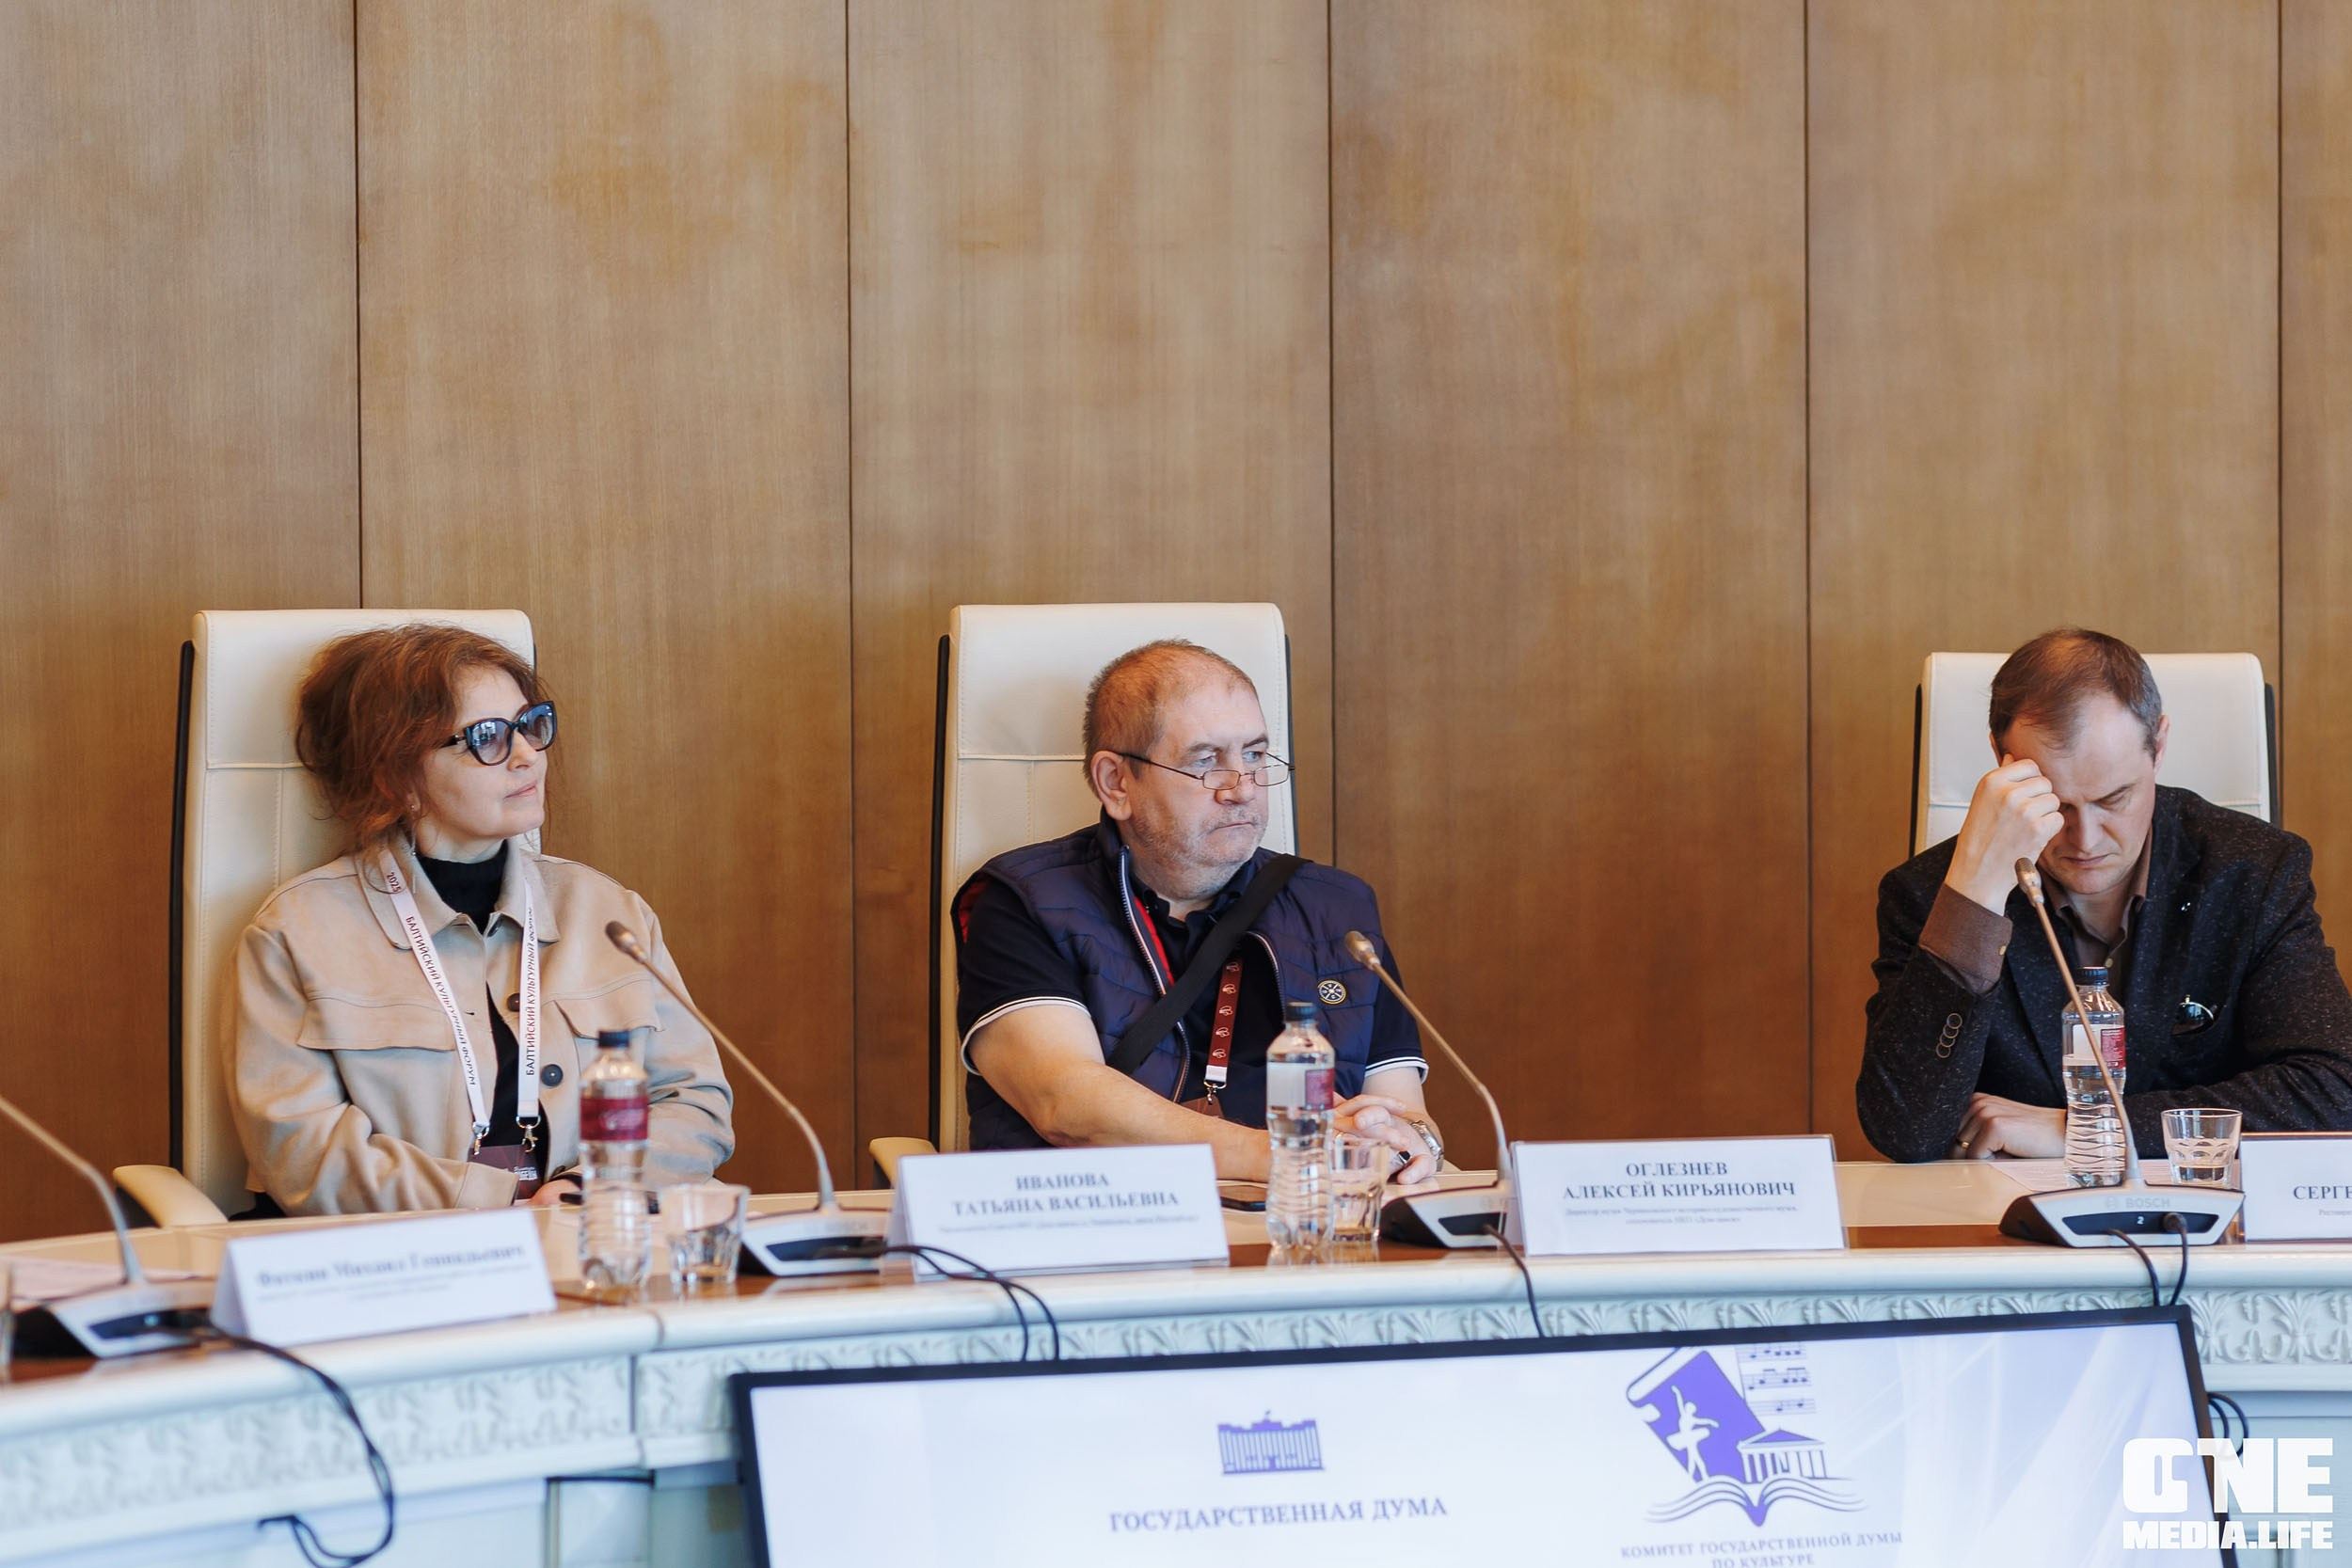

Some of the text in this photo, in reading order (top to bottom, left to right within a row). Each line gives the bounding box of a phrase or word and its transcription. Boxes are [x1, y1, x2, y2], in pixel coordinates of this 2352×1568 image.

[386, 871, 403, 893] 2025
[526, 942, 535, 1005] КУЛЬТУРНЫЙ
[405, 916, 441, 980] БАЛТИЙСКИЙ
[462, 1046, 477, 1085] ФОРУМ
[525, 1006, 535, 1077] БАЛТИЙСКИЙ
[1626, 1162, 1728, 1177] ОГЛЕЗНЕВ
[1016, 1173, 1109, 1191] ИВАНОВА
[1563, 1180, 1796, 1199] АЛЕКСЕЙ КИРЬЯНОВИЧ
[952, 1191, 1178, 1216] ТАТЬЯНА ВАСИЛЬЕВНА
[2125, 1196, 2170, 1208] BOSCH
[2137, 1215, 2144, 1225] 2
[1109, 1497, 1448, 1532] ГОСУДАРСТВЕННАЯ ДУМА
[1621, 1531, 1903, 1559] КОМИТЕТ ГОСУДАРСТВЕННОЙ ДУМЫ
[1711, 1553, 1815, 1568] ПО КУЛЬТУРЕ
